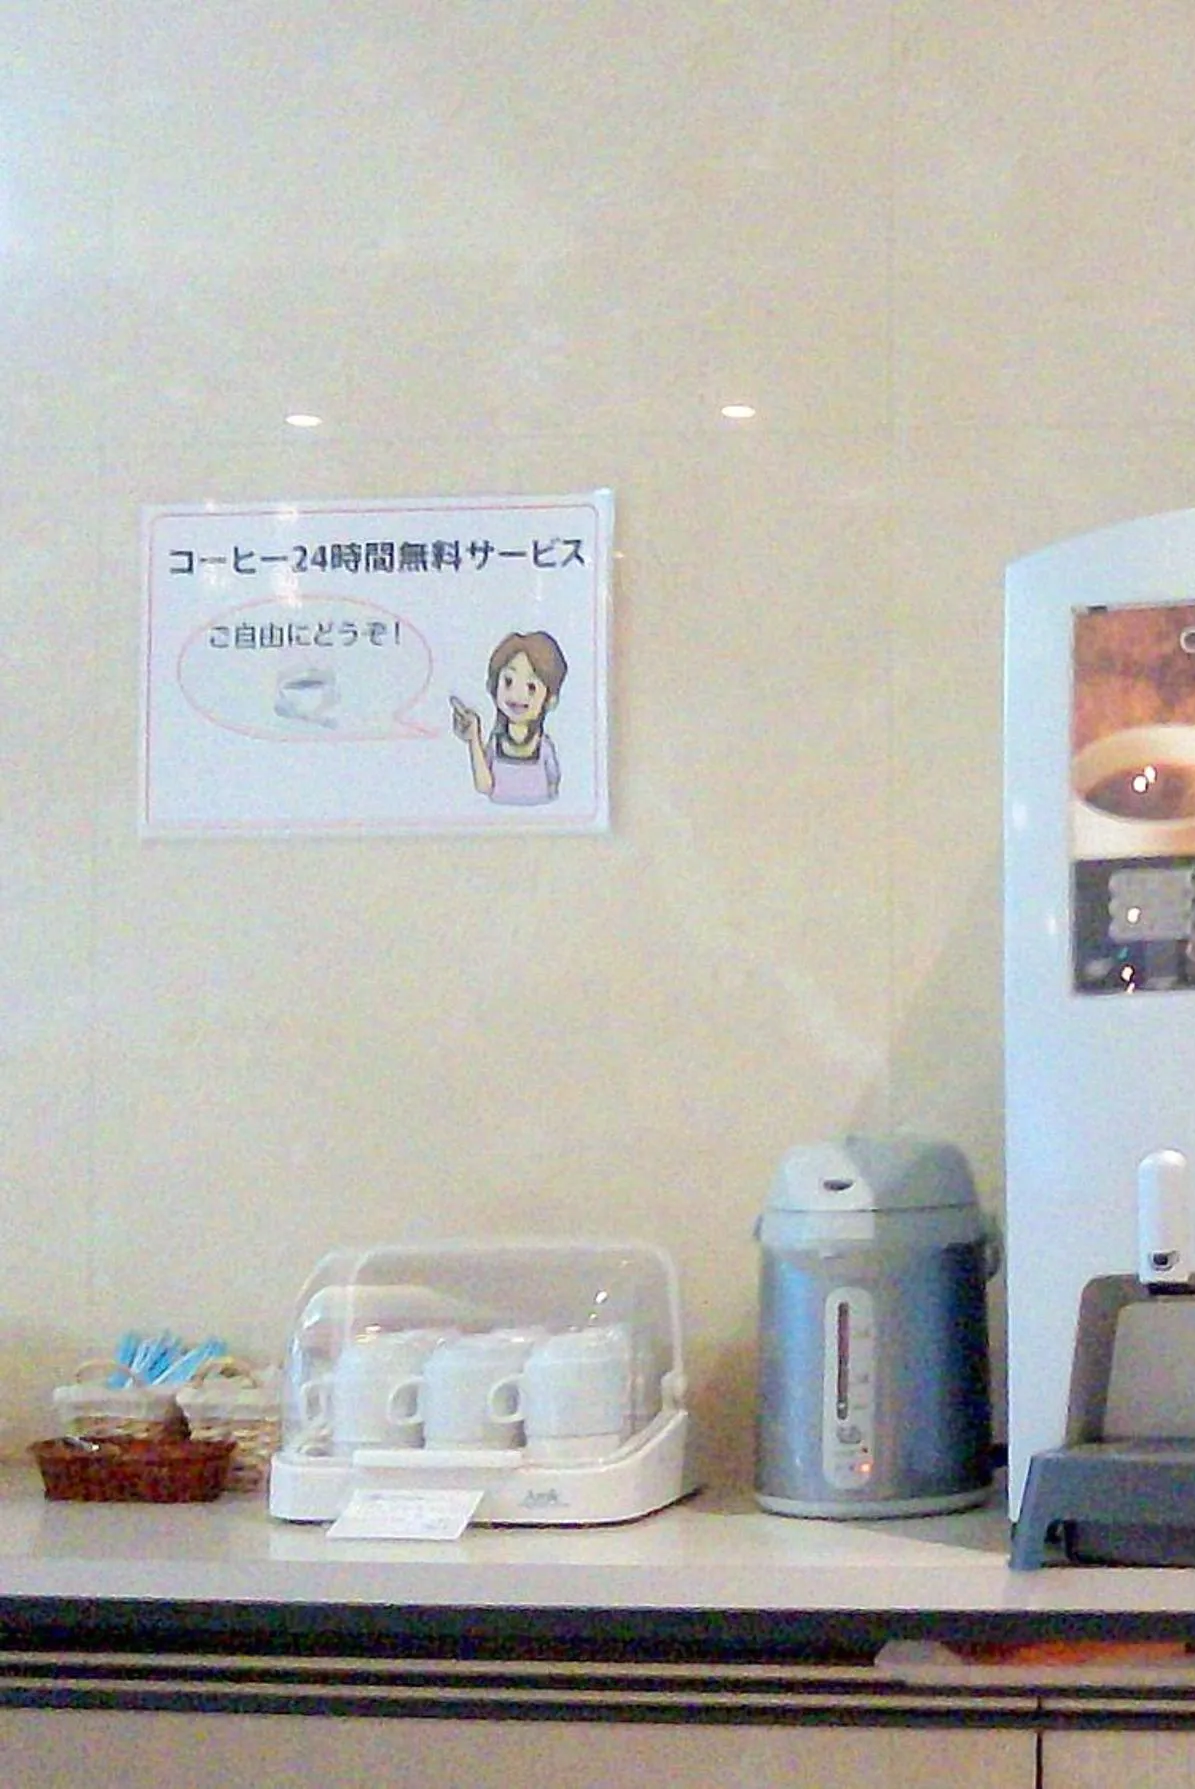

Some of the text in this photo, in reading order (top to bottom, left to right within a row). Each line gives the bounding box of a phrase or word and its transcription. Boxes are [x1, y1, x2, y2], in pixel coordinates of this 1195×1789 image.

[168, 538, 586, 576] コーヒー24時間無料サービス
